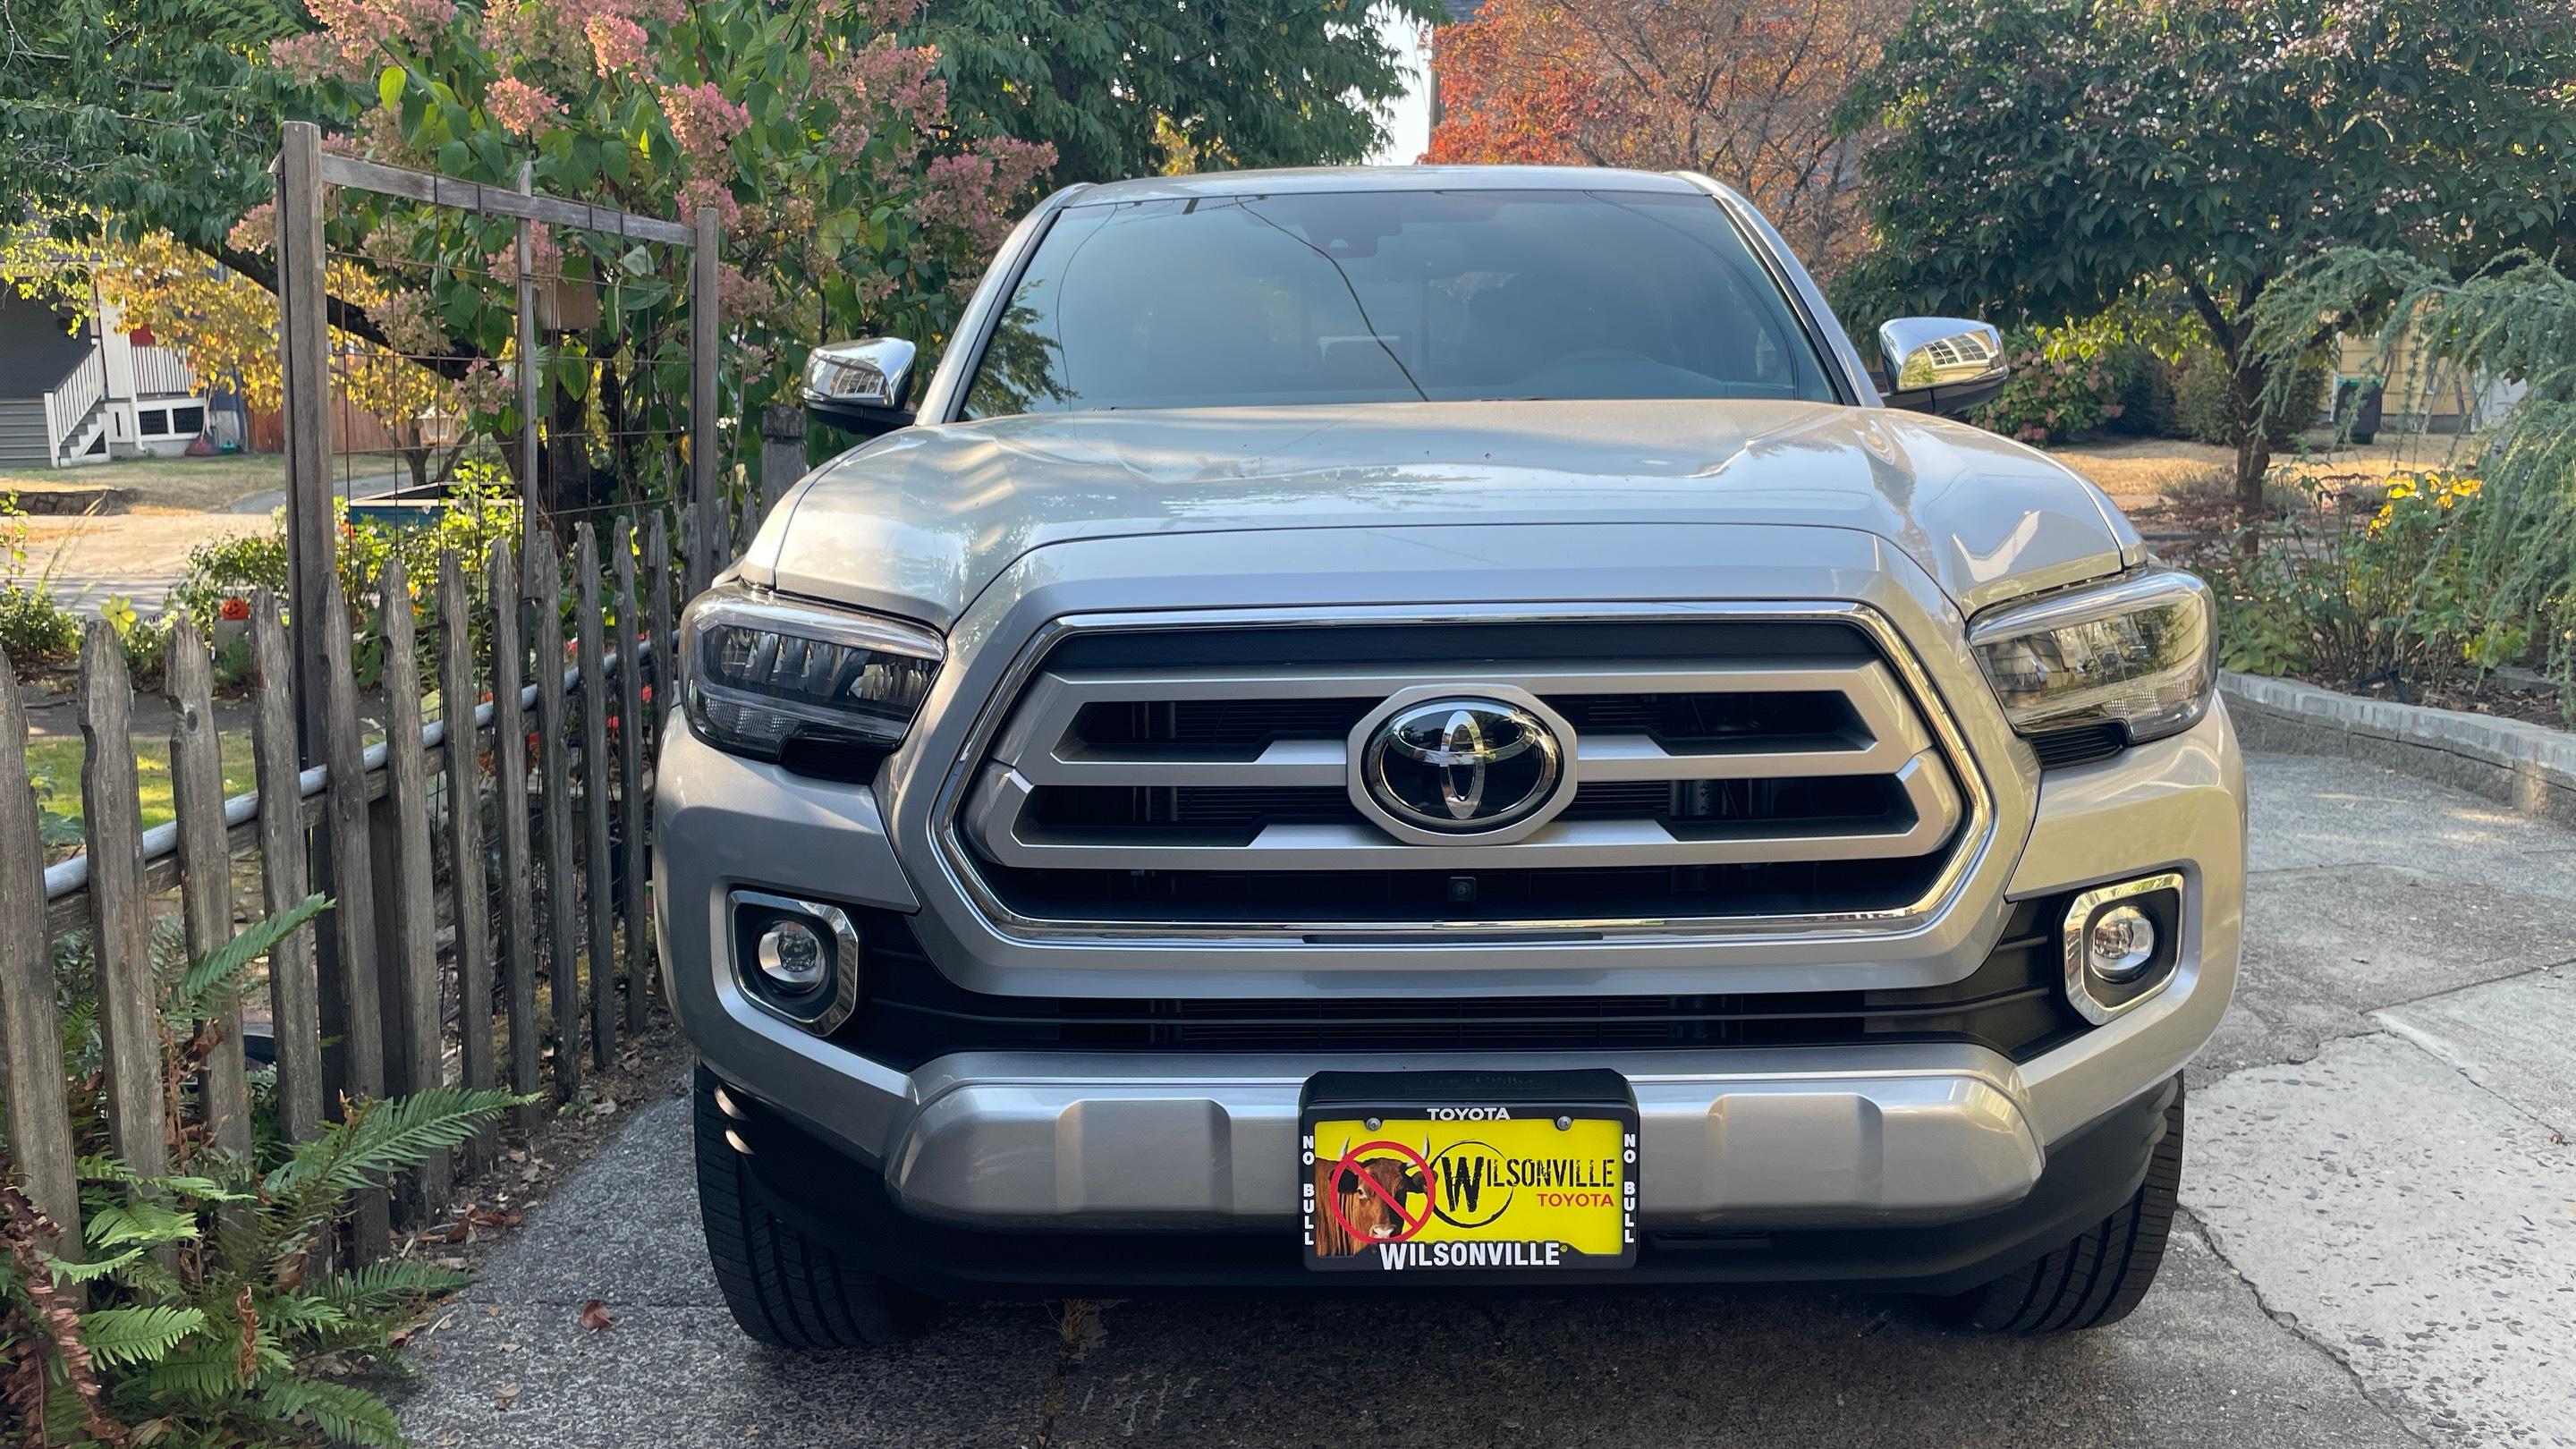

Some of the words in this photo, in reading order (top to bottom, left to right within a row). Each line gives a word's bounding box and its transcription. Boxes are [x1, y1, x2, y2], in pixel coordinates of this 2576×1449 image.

[1427, 1108, 1510, 1121] TOYOTA
[1303, 1136, 1314, 1165] NO
[1624, 1134, 1635, 1164] NO
[1441, 1155, 1614, 1213] WILSONVILLE
[1303, 1183, 1314, 1245] BULL
[1538, 1193, 1614, 1208] TOYOTA
[1624, 1182, 1635, 1243] BULL
[1378, 1242, 1560, 1270] WILSONVILLE
